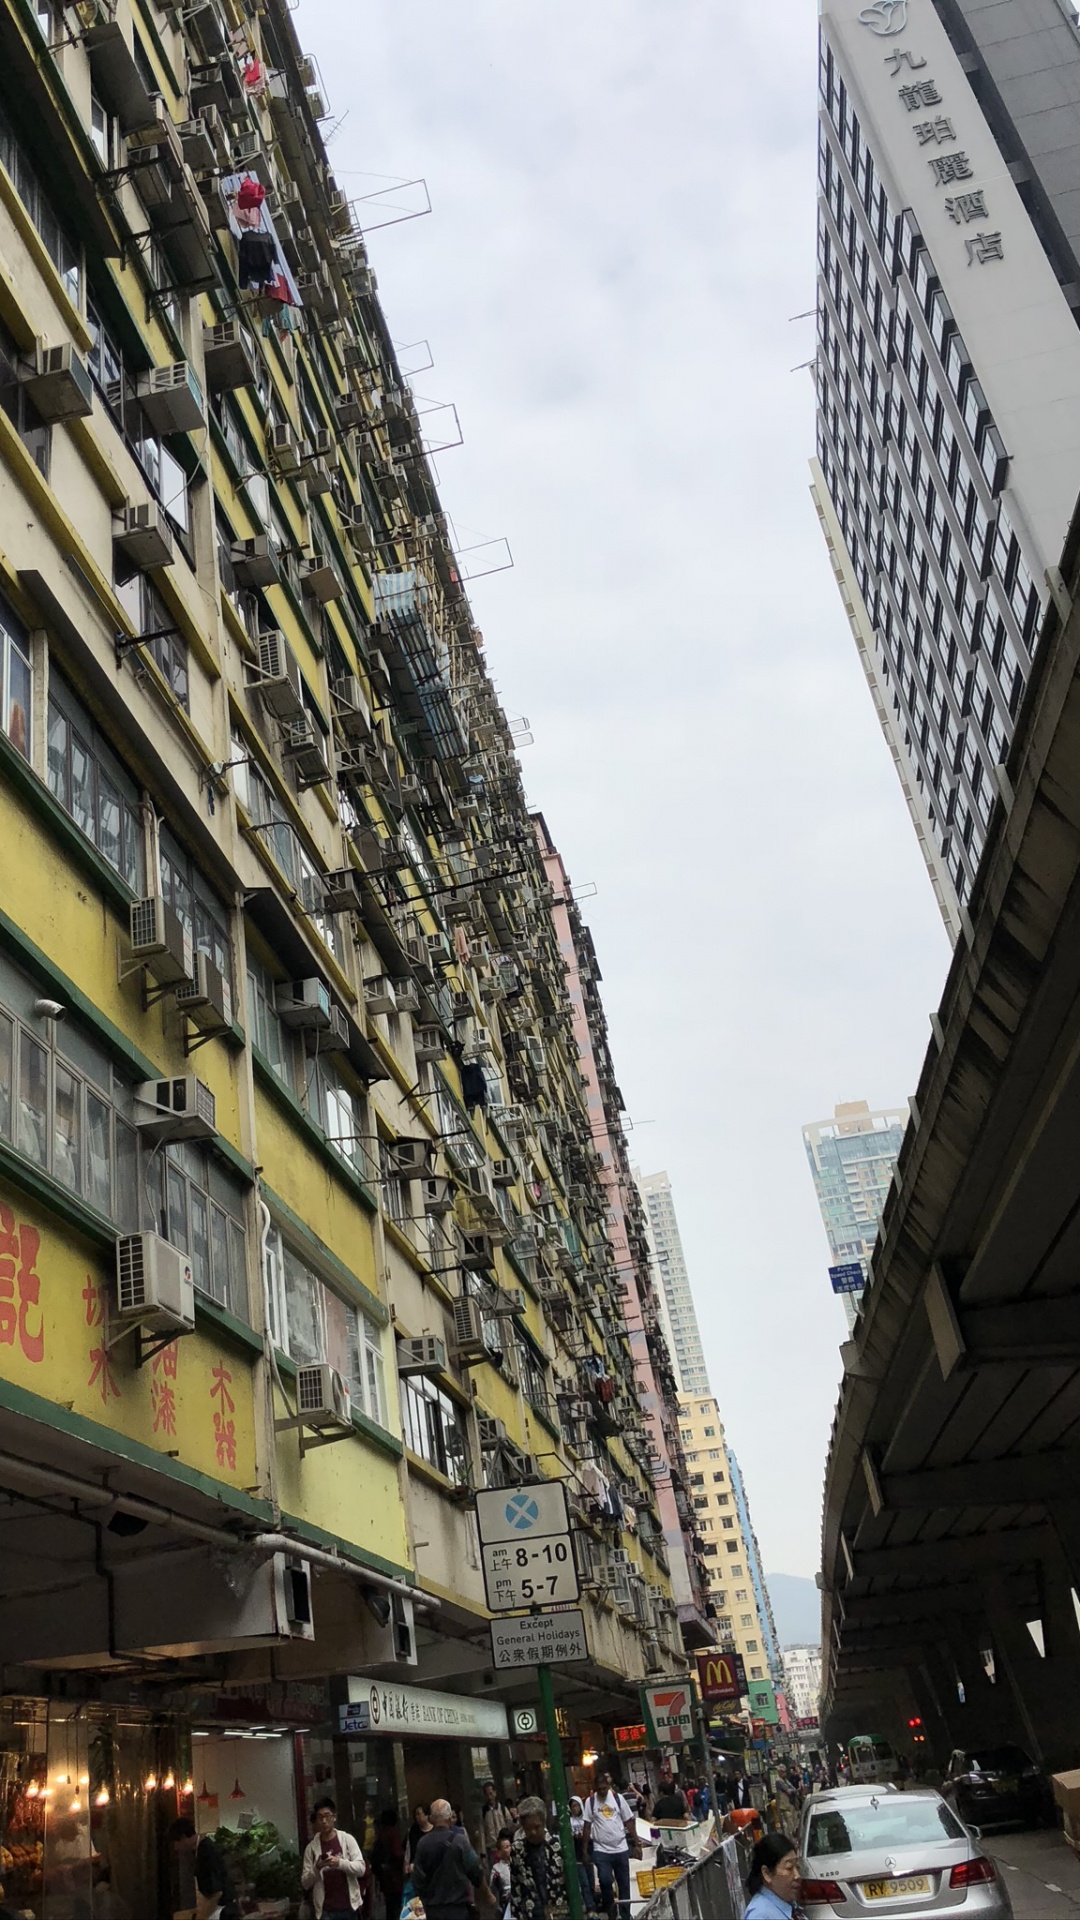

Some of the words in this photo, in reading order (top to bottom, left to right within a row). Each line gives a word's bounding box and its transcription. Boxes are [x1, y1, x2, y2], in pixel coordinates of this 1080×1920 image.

[884, 48, 1005, 267] 九龍珀麗酒店
[492, 1549, 507, 1557] am
[490, 1558, 512, 1571] 上午
[496, 1579, 512, 1589] pm
[493, 1589, 516, 1603] 下午
[520, 1618, 554, 1630] Except
[496, 1633, 535, 1646] General
[538, 1629, 580, 1641] Holidays
[653, 1691, 686, 1743] 7
[868, 1882, 885, 1897] RY
[889, 1879, 924, 1894] 9509
